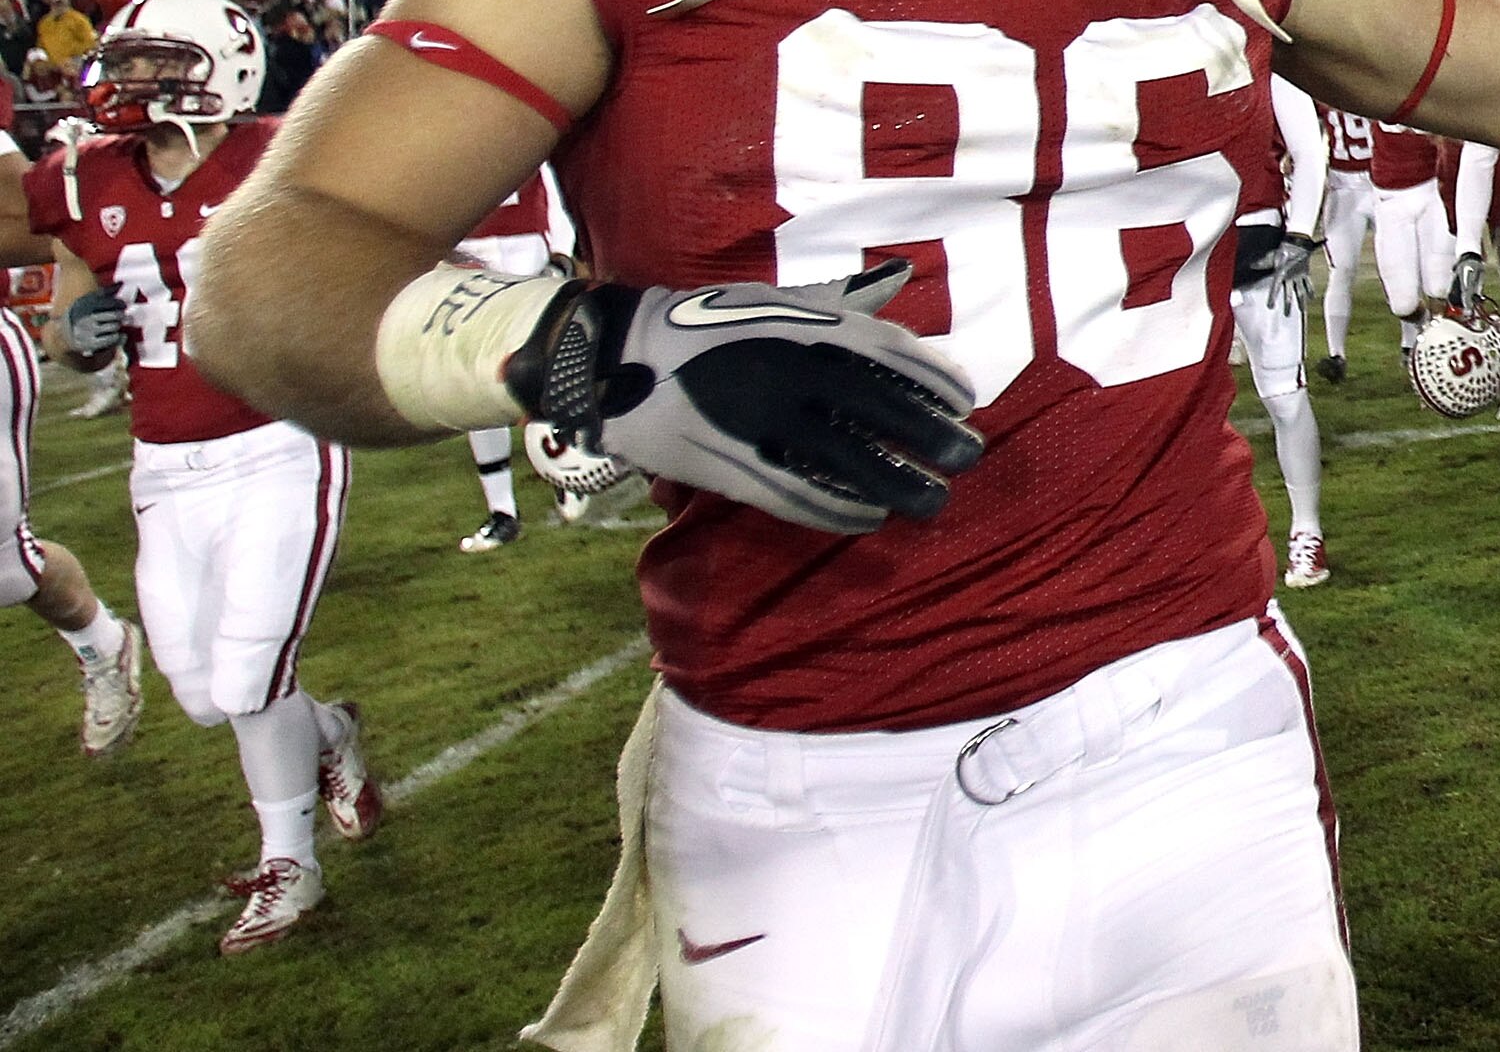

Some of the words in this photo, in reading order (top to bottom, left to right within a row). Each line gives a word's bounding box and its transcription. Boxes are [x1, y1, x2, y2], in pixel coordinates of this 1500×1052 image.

[1327, 110, 1374, 162] 19
[774, 4, 1254, 411] 86
[113, 237, 204, 368] 4
[1450, 345, 1484, 377] S
